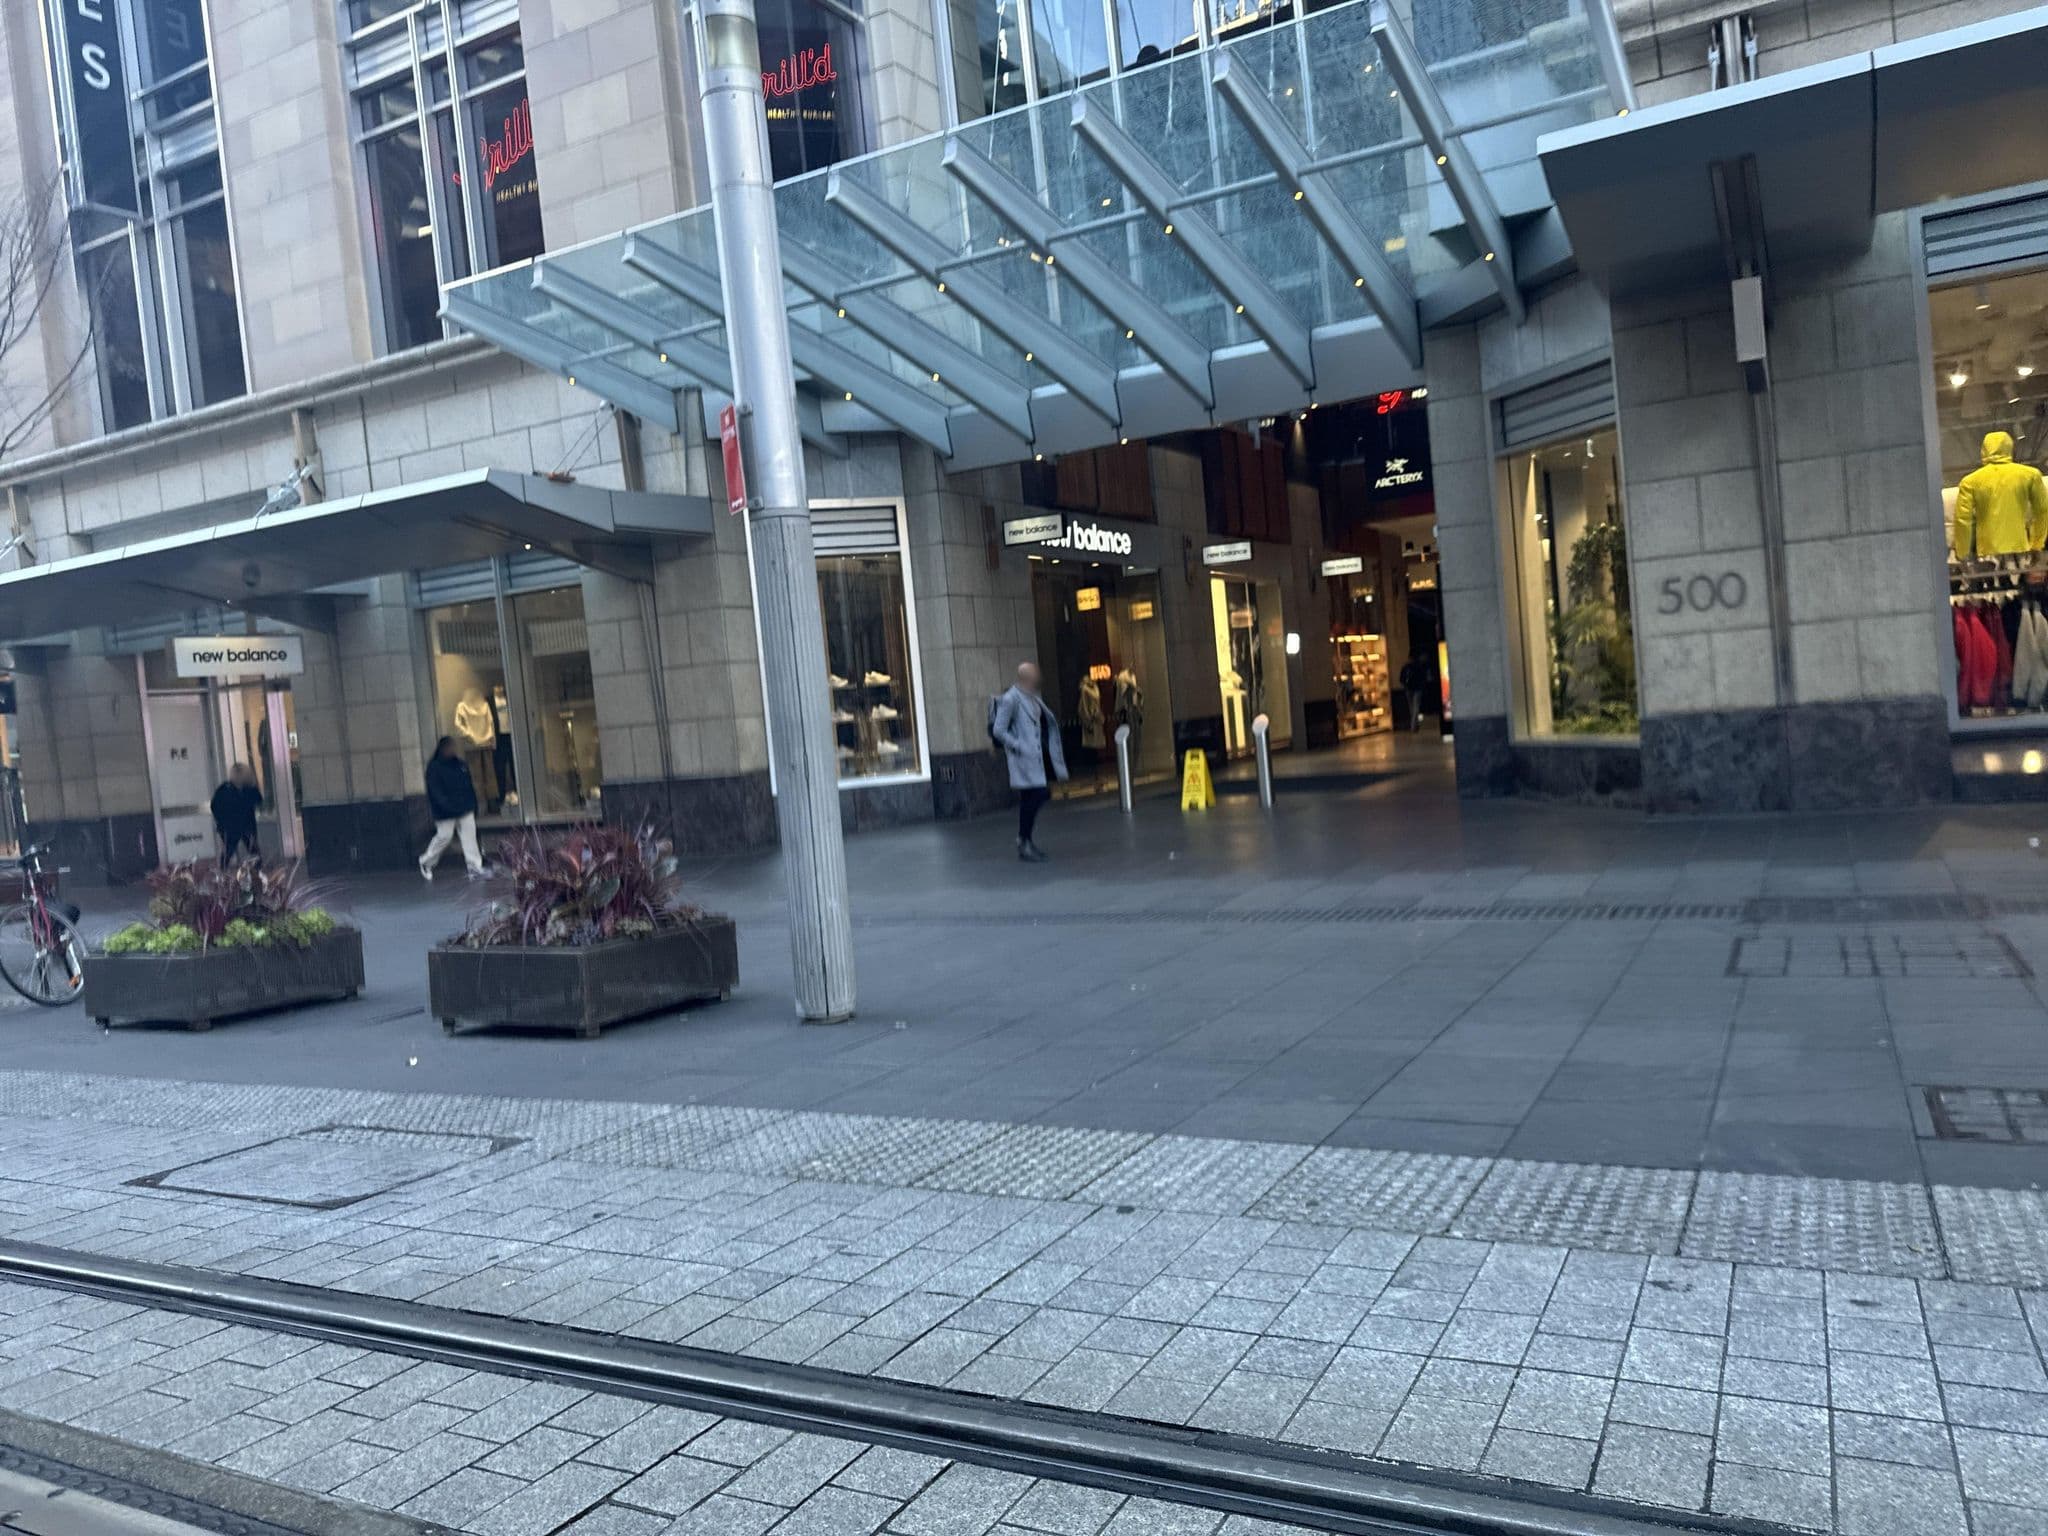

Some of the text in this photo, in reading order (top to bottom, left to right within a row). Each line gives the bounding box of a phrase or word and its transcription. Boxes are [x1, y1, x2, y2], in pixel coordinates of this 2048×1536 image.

[472, 98, 534, 192] rill
[1025, 523, 1058, 535] balance
[1072, 520, 1132, 555] balance
[1657, 571, 1747, 615] 500
[192, 648, 288, 662] new balance
